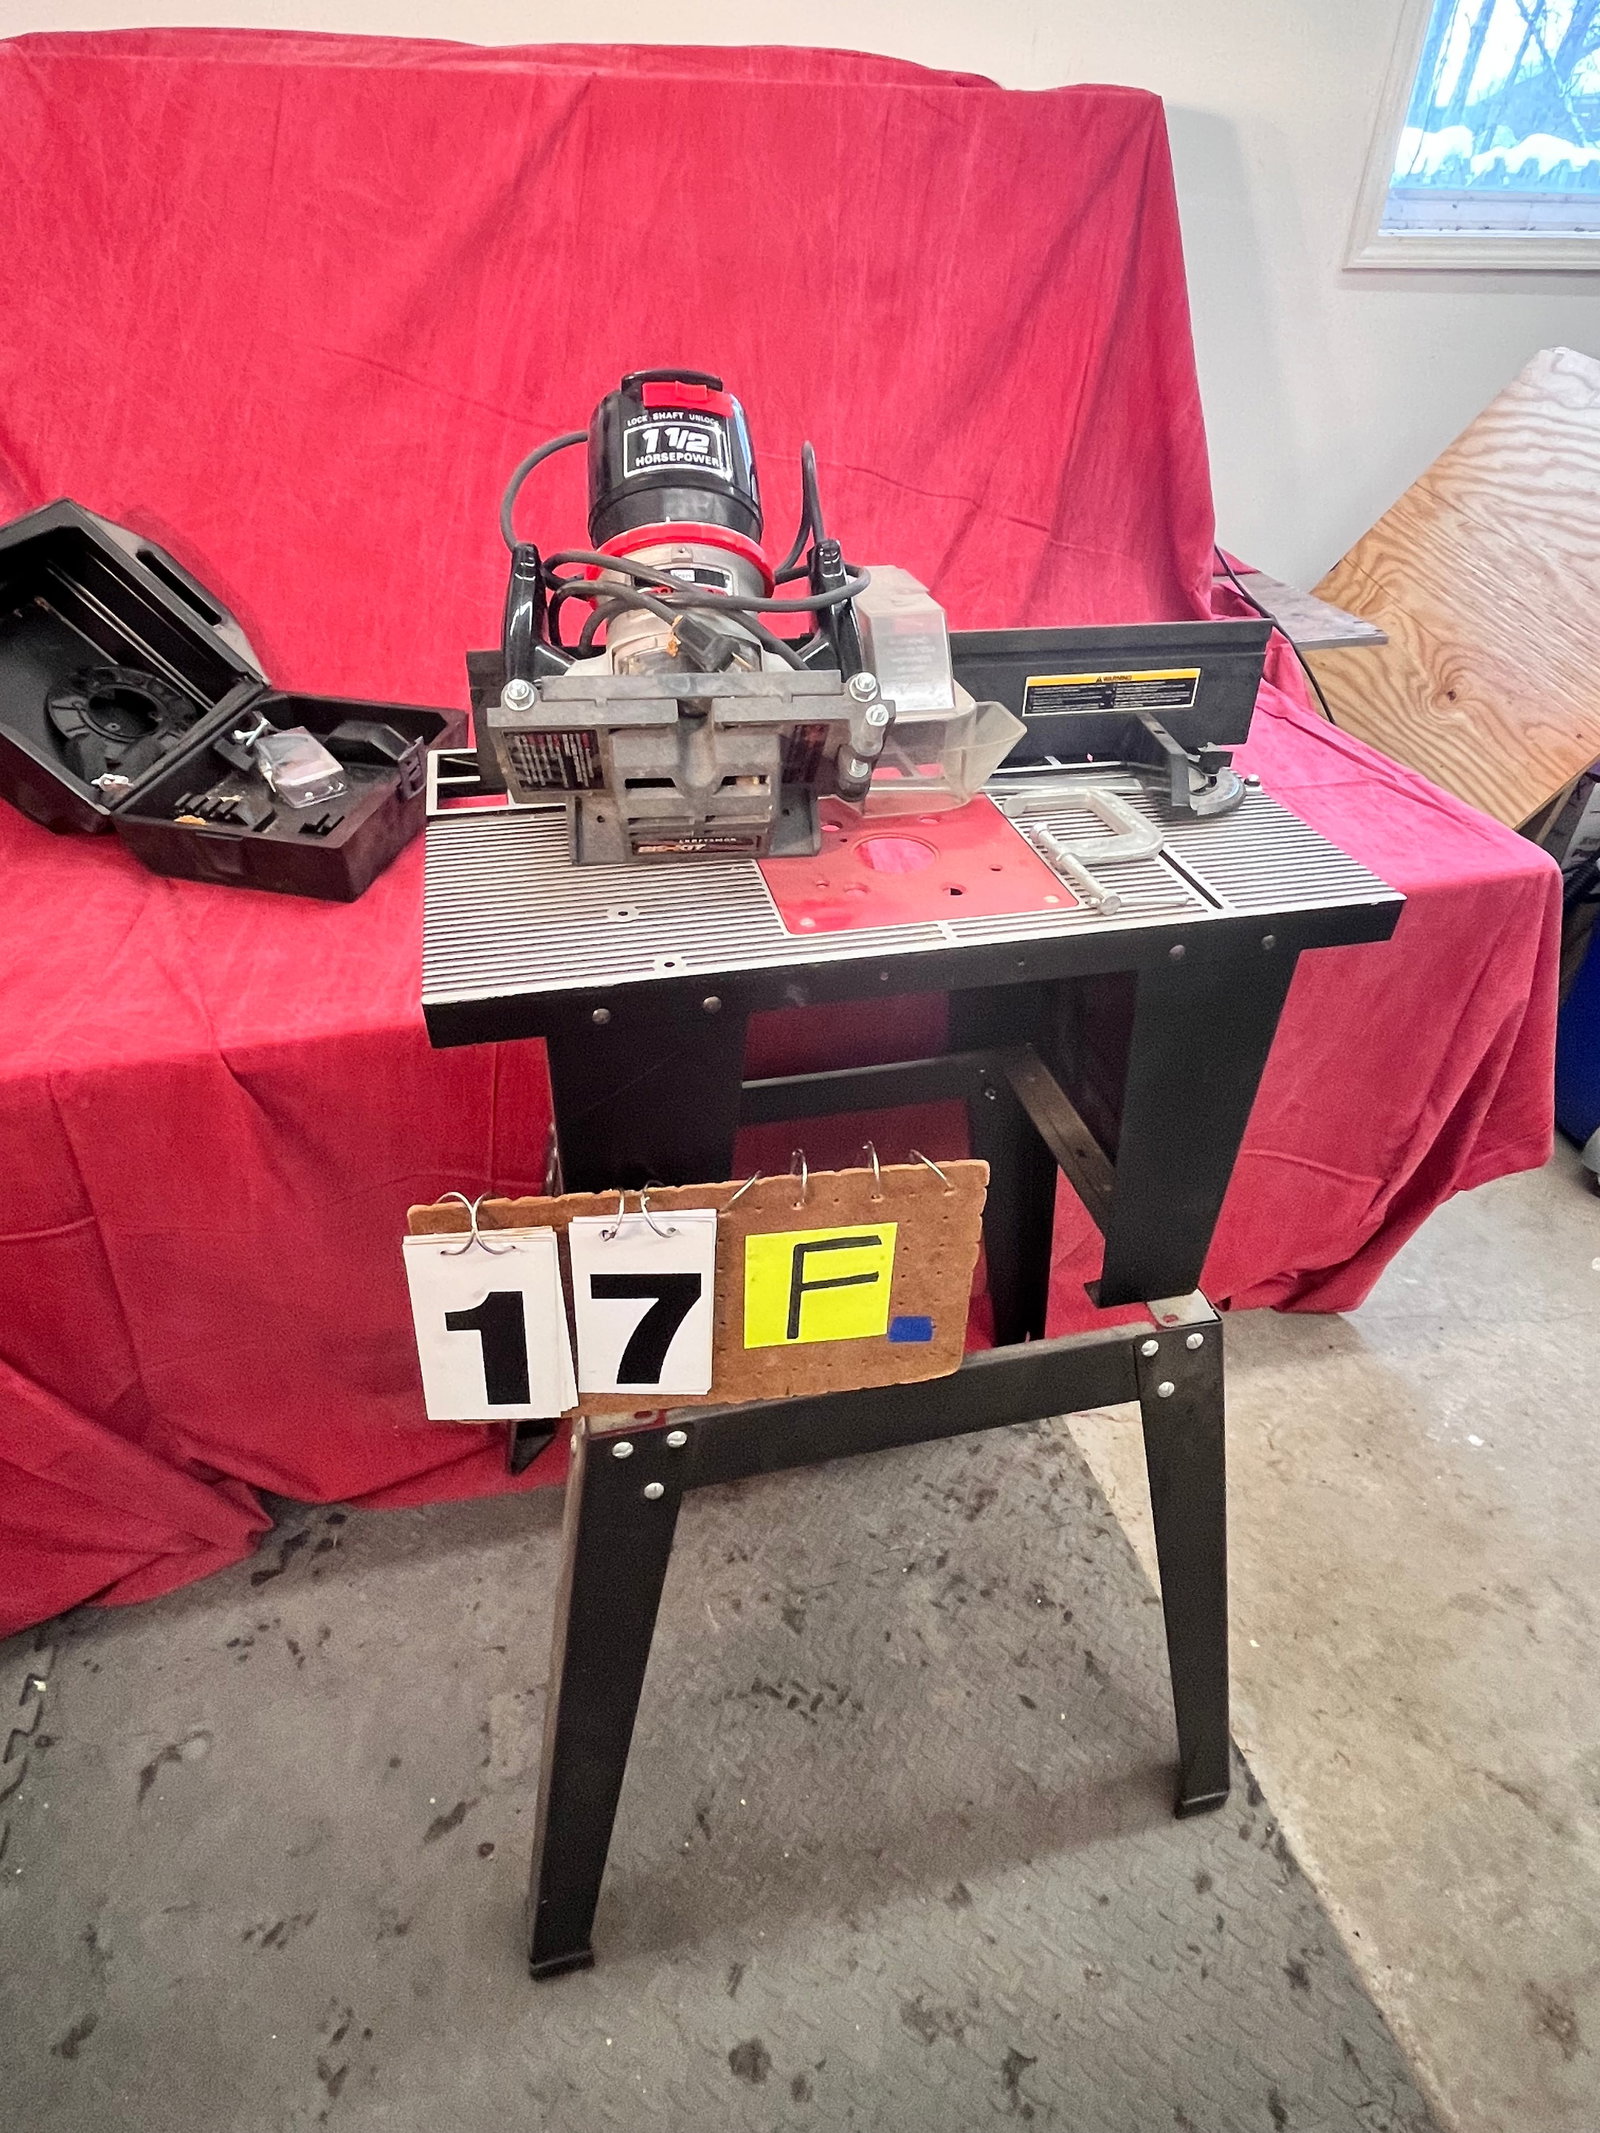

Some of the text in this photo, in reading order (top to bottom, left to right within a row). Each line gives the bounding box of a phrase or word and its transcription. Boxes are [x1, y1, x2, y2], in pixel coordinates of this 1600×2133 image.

[627, 415, 648, 426] LOCK
[653, 411, 684, 420] SHAFT
[642, 427, 710, 454] 1 1/2
[635, 452, 720, 467] HORSEPOWER
[786, 1235, 881, 1340] F
[445, 1273, 701, 1405] 1 7
